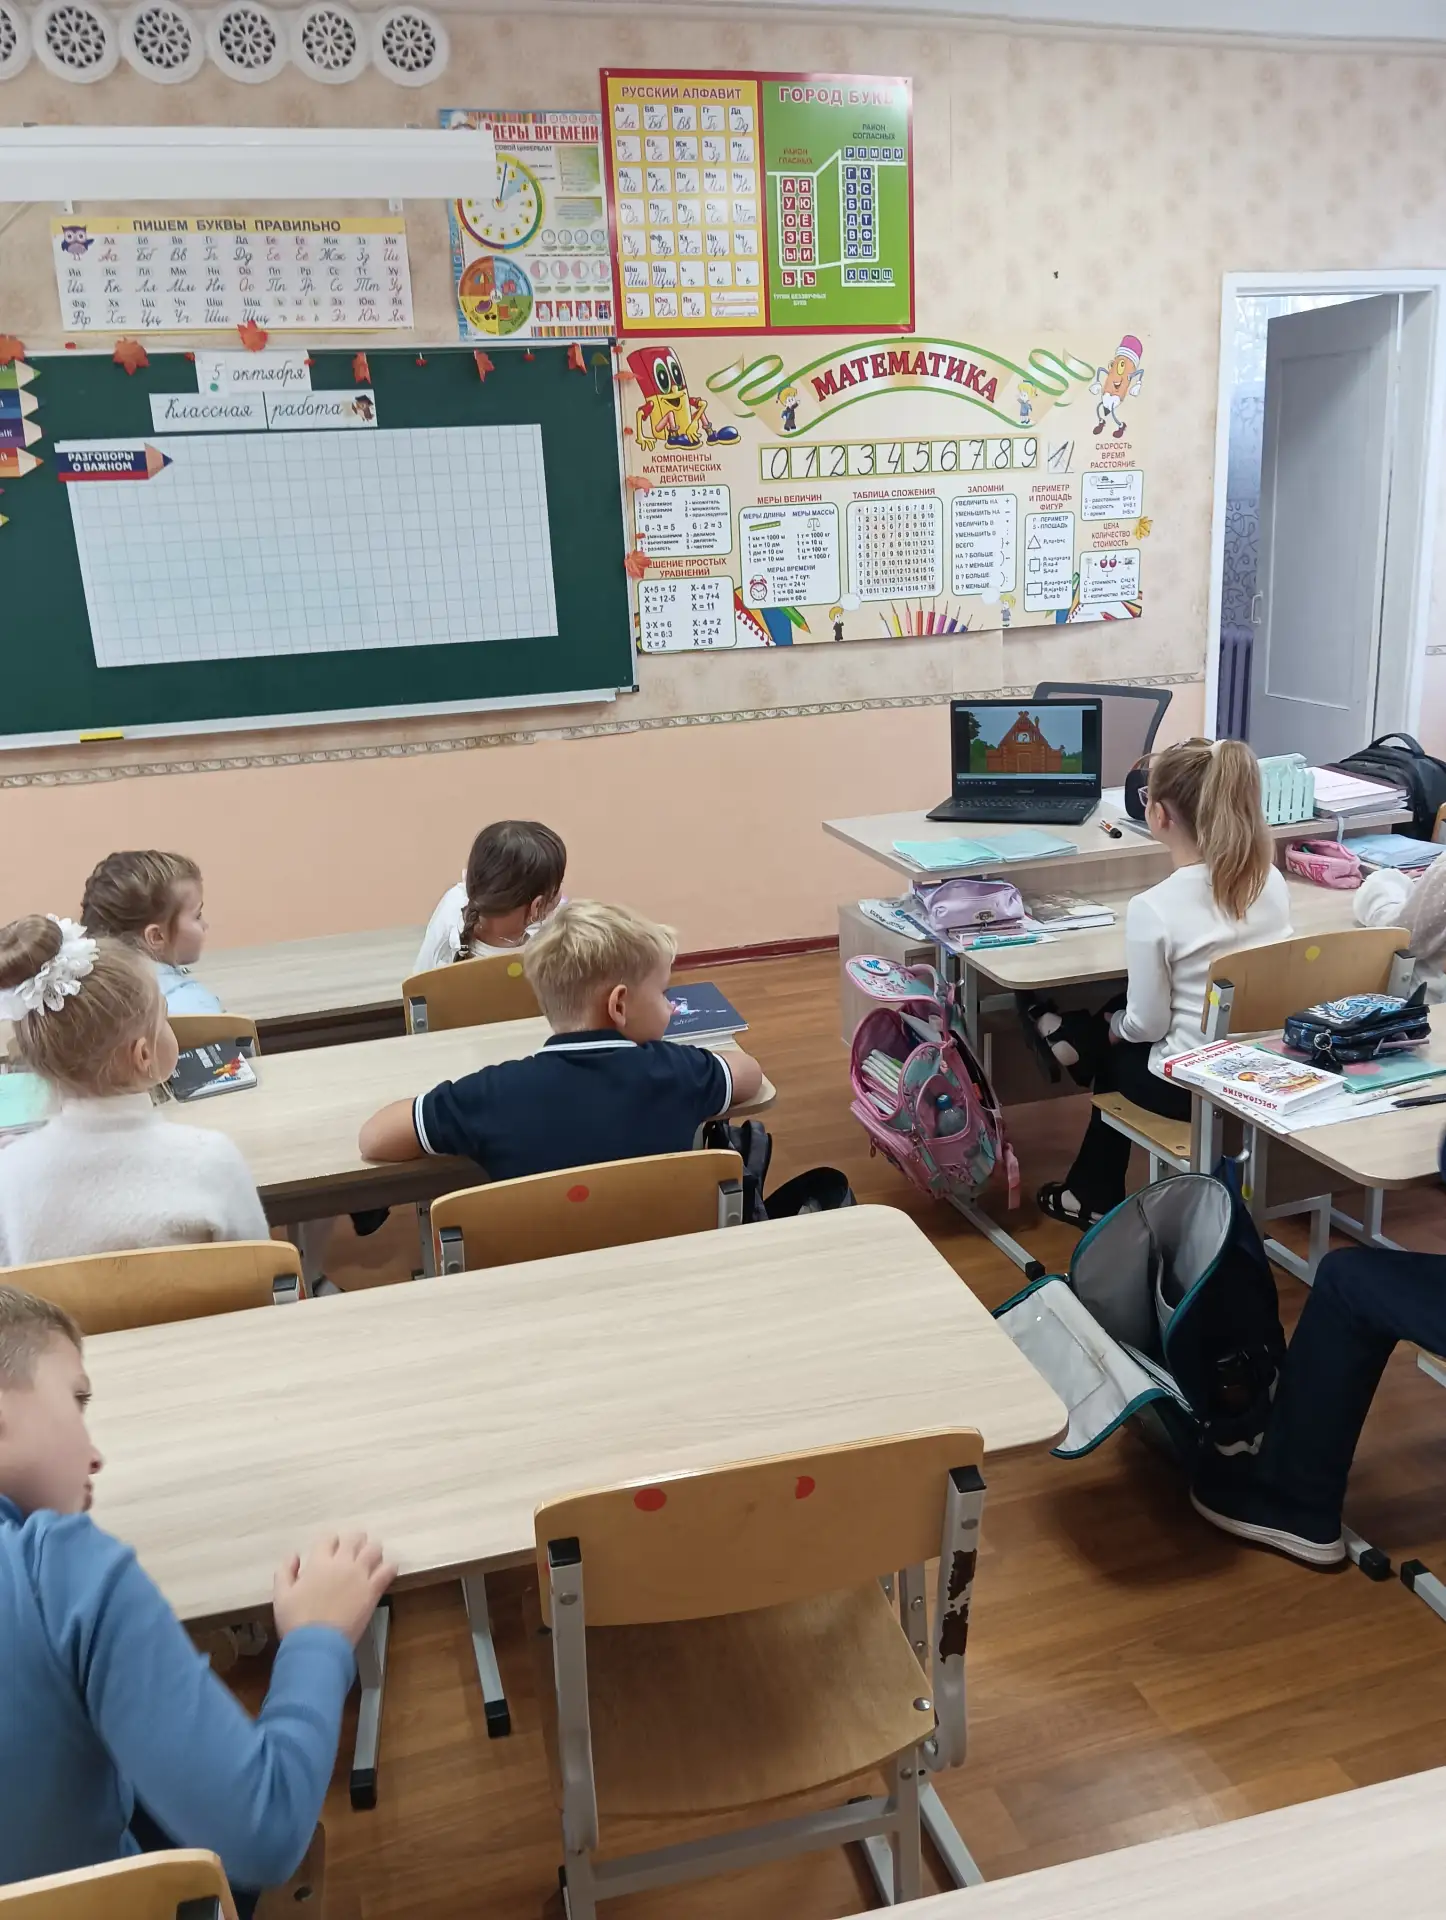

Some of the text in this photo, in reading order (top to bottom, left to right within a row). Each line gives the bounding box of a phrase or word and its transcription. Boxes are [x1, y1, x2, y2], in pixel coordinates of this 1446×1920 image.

[621, 86, 742, 100] РУССКИЙ АЛФАВИТ
[780, 87, 843, 106] ГОРОД
[862, 123, 886, 132] РАЙОН
[535, 125, 599, 140] ВРЕМЕНИ
[852, 132, 896, 140] СОГЛАСНЫХ
[783, 148, 808, 156] РАЙОН
[778, 157, 813, 165] ГЛАСНЫХ
[132, 219, 341, 232] ПИШЕМ БУКВЫ ПРАВИЛЬНО
[212, 360, 307, 388] 5 октября
[811, 350, 999, 403] МАТЕМАТИКА
[164, 395, 344, 425] Классная работа
[1095, 442, 1133, 451] СКОРОСТЬ
[68, 451, 134, 462] РАЗГОВОРЫ
[651, 453, 712, 463] КОМПОНЕНТЫ
[770, 437, 1038, 480] 0 1 2 3 4 5 6 7 8 9
[1101, 452, 1126, 460] ВРЕМЯ
[73, 461, 133, 472] О ВАЖНОМ
[642, 463, 722, 474] МАТЕМАТИЧЕСКИХ
[1090, 460, 1136, 469] РАССТОЯНИЕ
[660, 472, 706, 484] ДЕЙСТВИЙ
[968, 484, 1004, 494] ЗАПОМНИ
[1032, 484, 1070, 493] ПЕРИМЕТР
[853, 488, 935, 499] ТАБЛИЦА СЛОЖЕНИЯ
[757, 494, 822, 505] МЕРЫ ВЕЛИЧИН
[1035, 494, 1073, 503] ПЛОЩАДЬ
[1040, 502, 1064, 511] ФИГУР
[743, 511, 786, 520] МЕРЫ ДЛИНЫ
[812, 509, 835, 517] МАССЫ
[1040, 515, 1069, 523] ПЕРИМЕТР
[1040, 523, 1068, 531] ПЛОЩАДЬ
[1103, 522, 1120, 530] ЦЕНА
[1091, 530, 1131, 539] КОЛИЧЕСТВО
[1092, 539, 1129, 548] СТОИМОСТЬ
[648, 558, 727, 569] ЕШЕНИЕ ПРОСТЫХ
[786, 564, 816, 572] ВРЕМЕНИ
[659, 567, 710, 578] УРАВНЕНИЙ
[706, 602, 714, 610] 11
[1222, 1086, 1278, 1111] ХРЕСТОМАТИЯ
